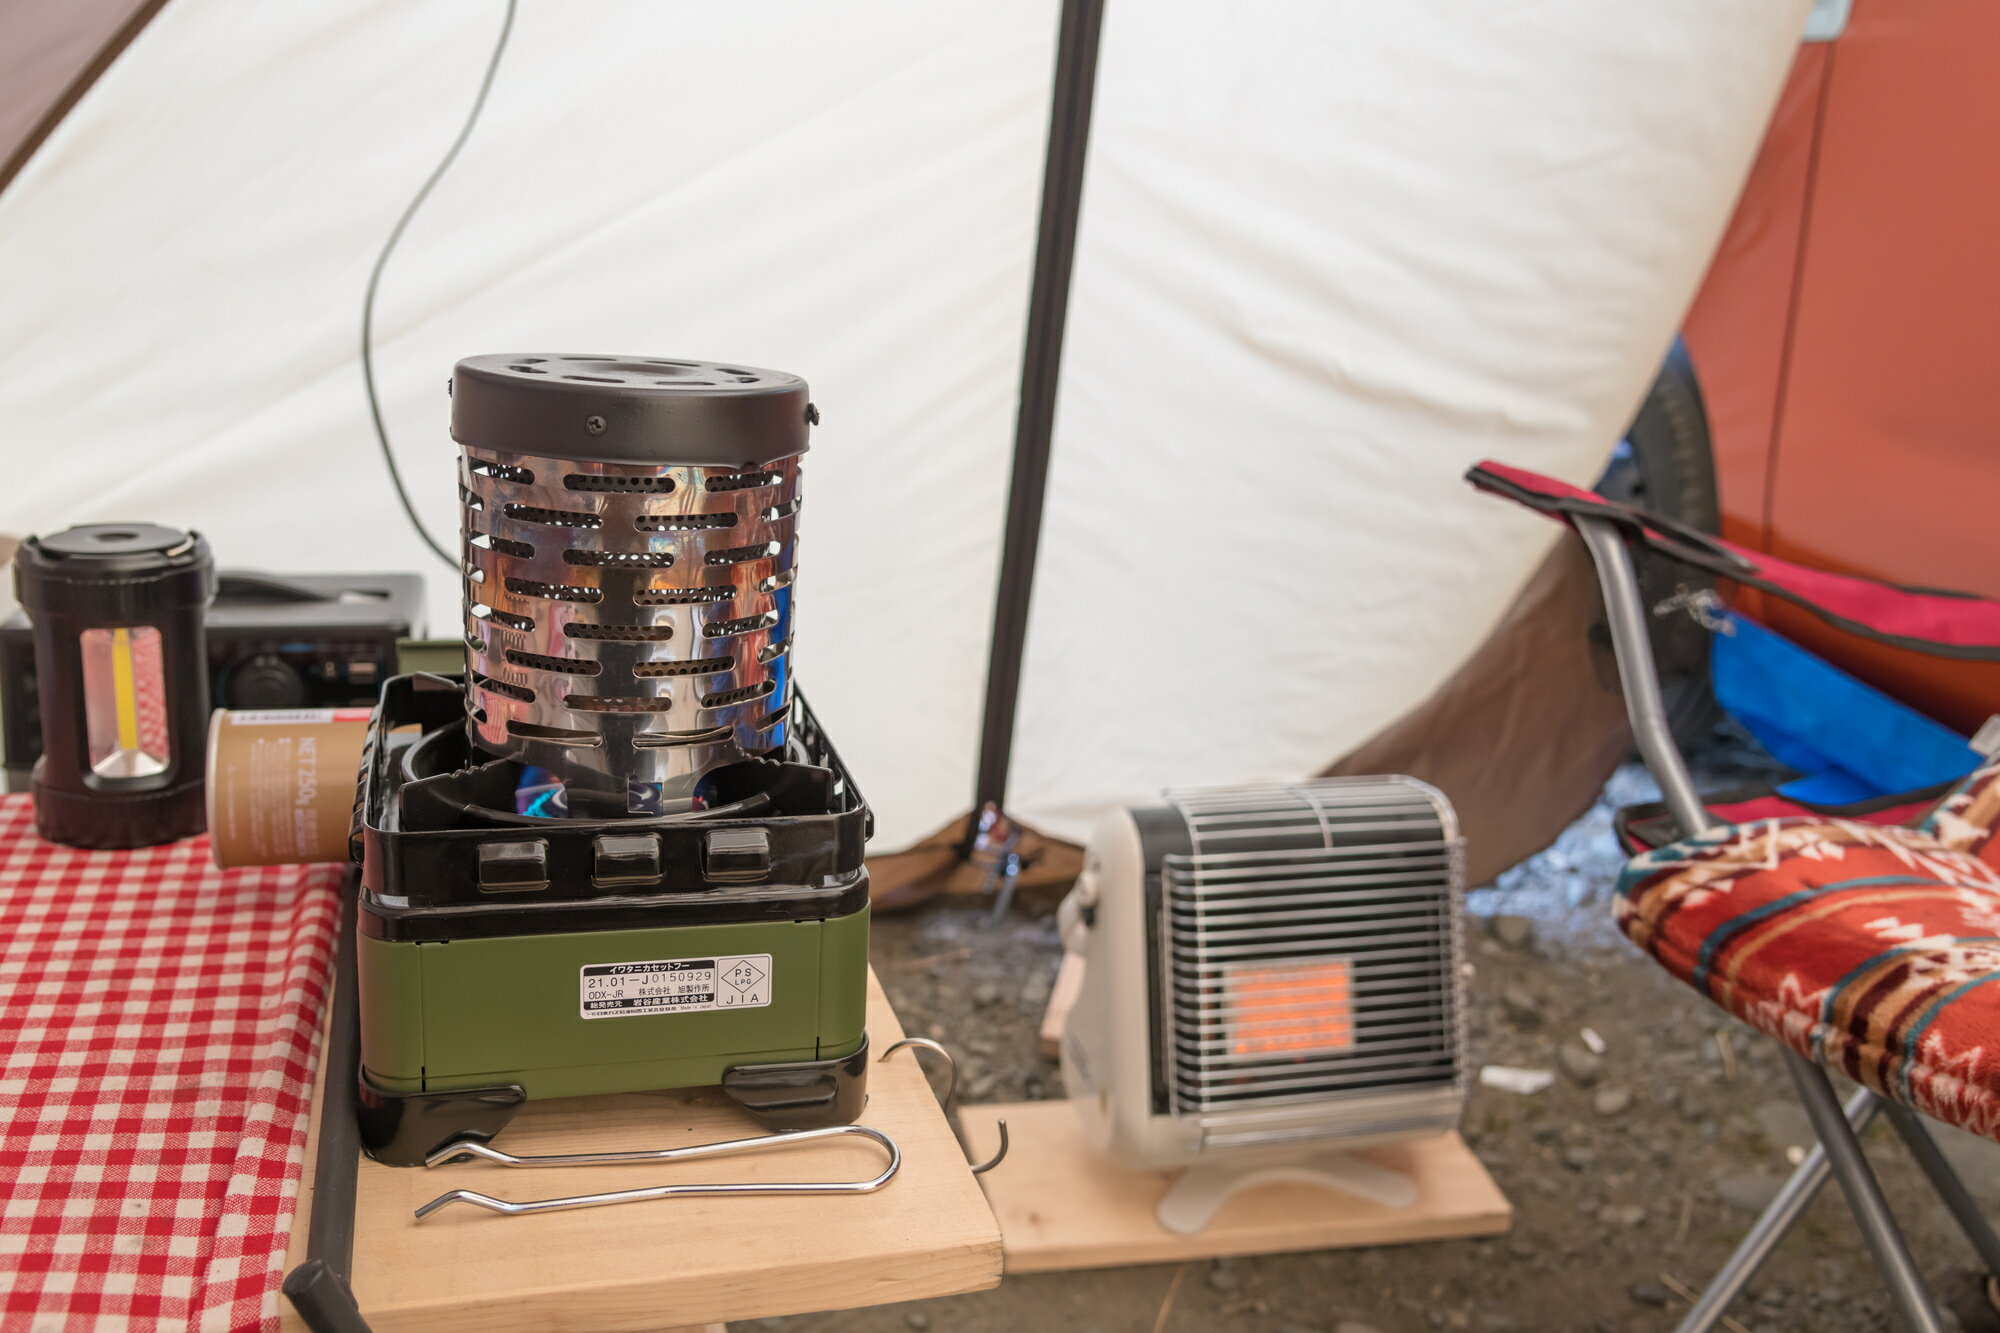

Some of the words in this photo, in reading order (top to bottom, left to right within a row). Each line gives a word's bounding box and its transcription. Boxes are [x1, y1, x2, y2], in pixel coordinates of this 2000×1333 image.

[298, 737, 317, 764] NET
[609, 962, 690, 974] イワタニカセットフー
[638, 986, 671, 996] 株式会社
[677, 984, 710, 993] 旭製作所
[633, 995, 708, 1007] 岩谷産業株式会社
